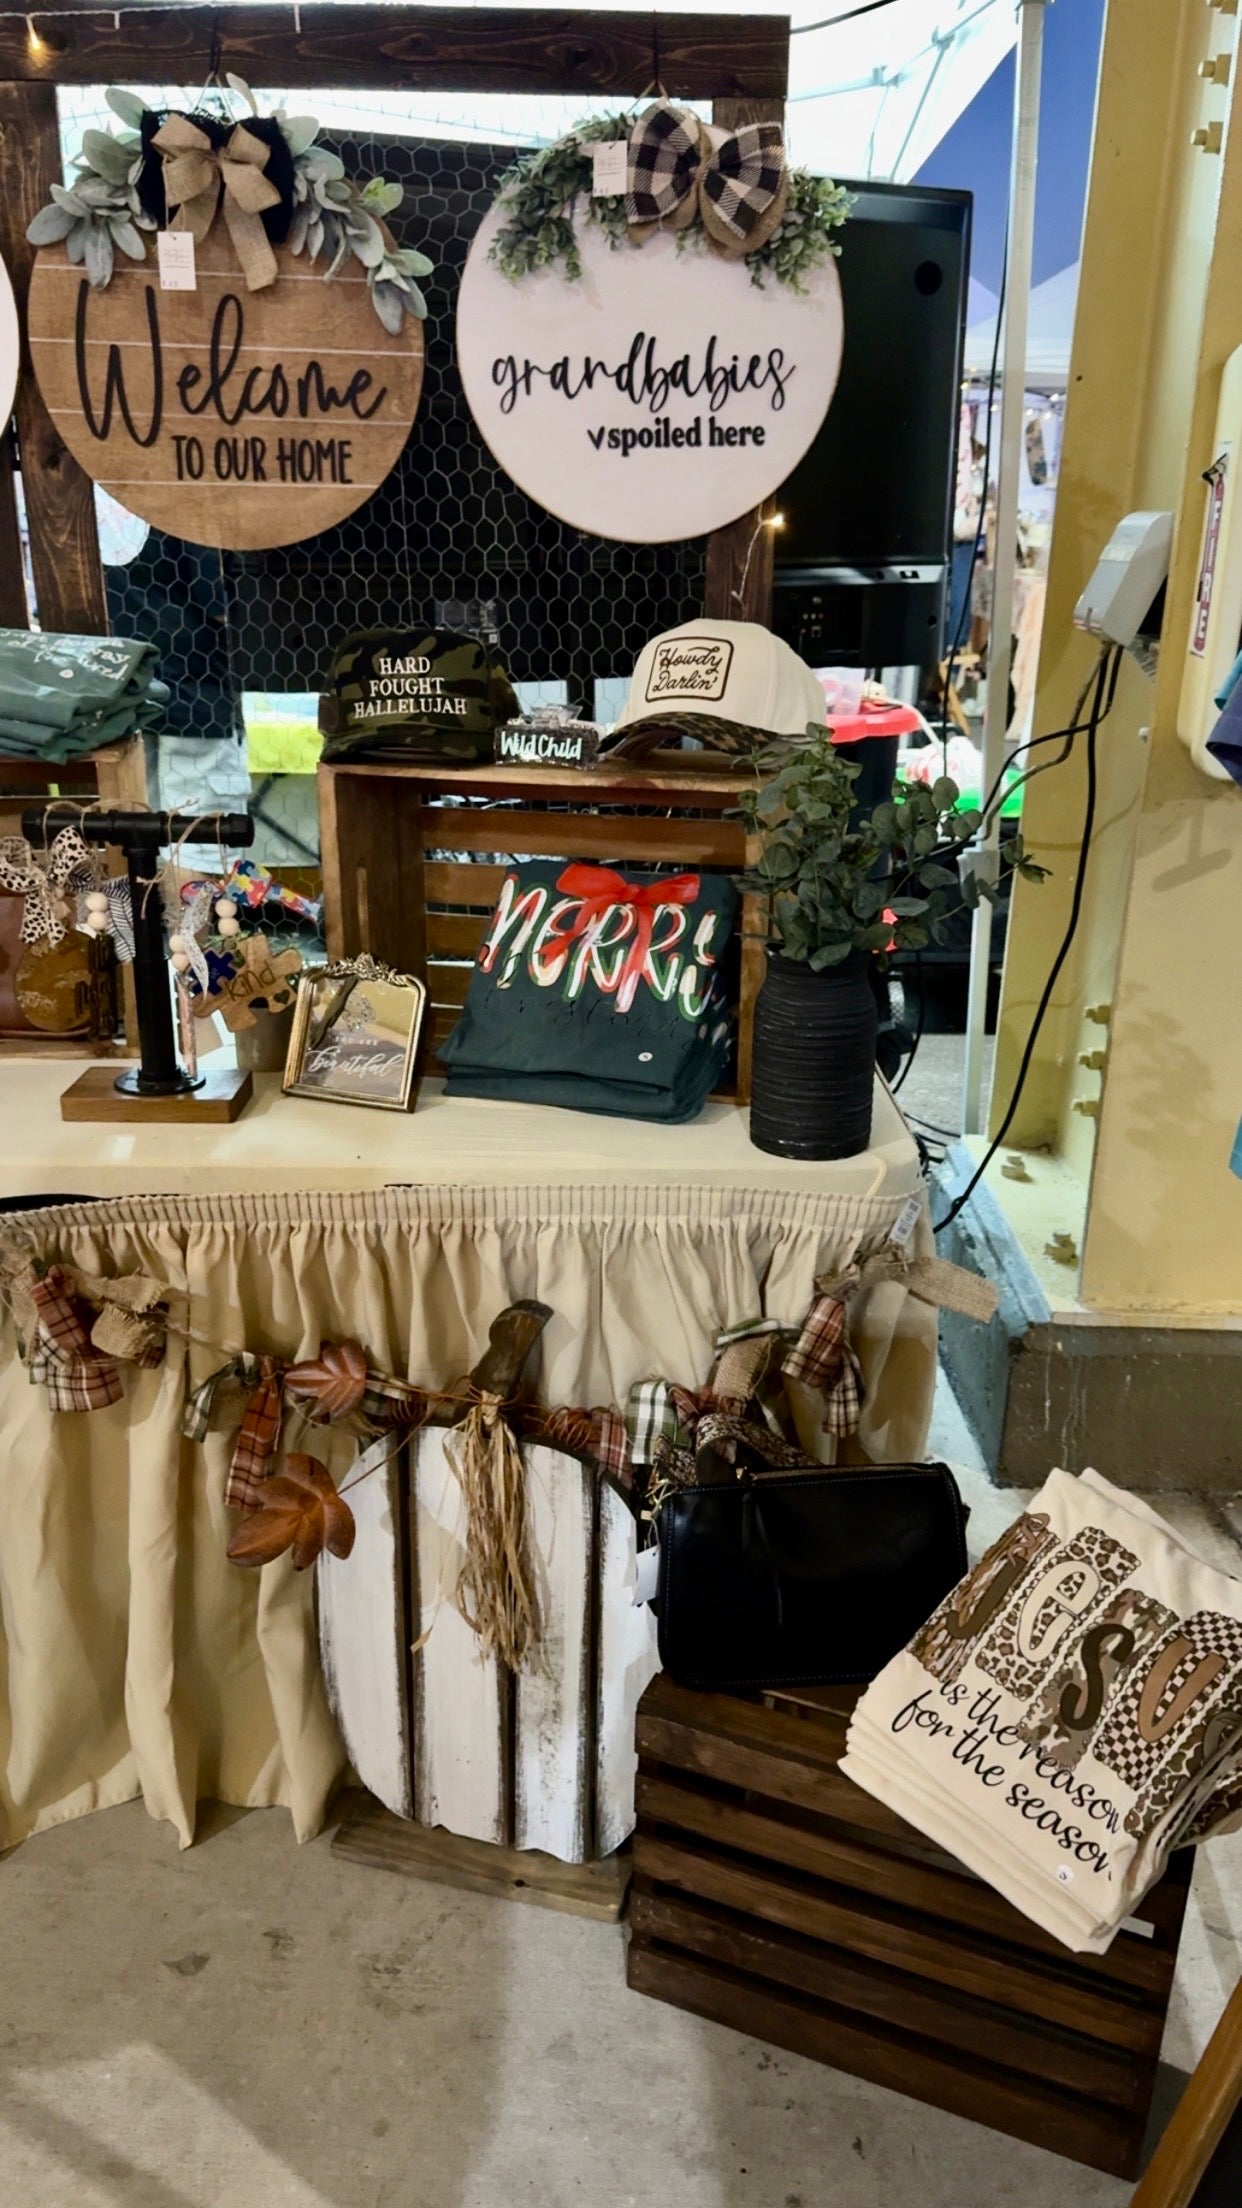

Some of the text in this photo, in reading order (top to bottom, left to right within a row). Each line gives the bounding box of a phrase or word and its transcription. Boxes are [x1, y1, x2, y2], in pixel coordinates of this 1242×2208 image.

[76, 279, 389, 448] Welcome
[492, 331, 797, 414] grandbabies
[608, 416, 702, 457] spoiled
[708, 415, 766, 448] here
[171, 435, 353, 484] TO OUR HOME
[379, 656, 431, 675] HARD
[659, 646, 723, 675] Howdy
[369, 677, 445, 697] FOUGHT
[652, 669, 719, 692] Darlin'
[354, 697, 467, 719] HALLELUJAH
[501, 730, 583, 761] Wild Child
[891, 1689, 955, 1737] for
[951, 1727, 1006, 1787] the
[939, 1678, 1120, 1834] is the reason
